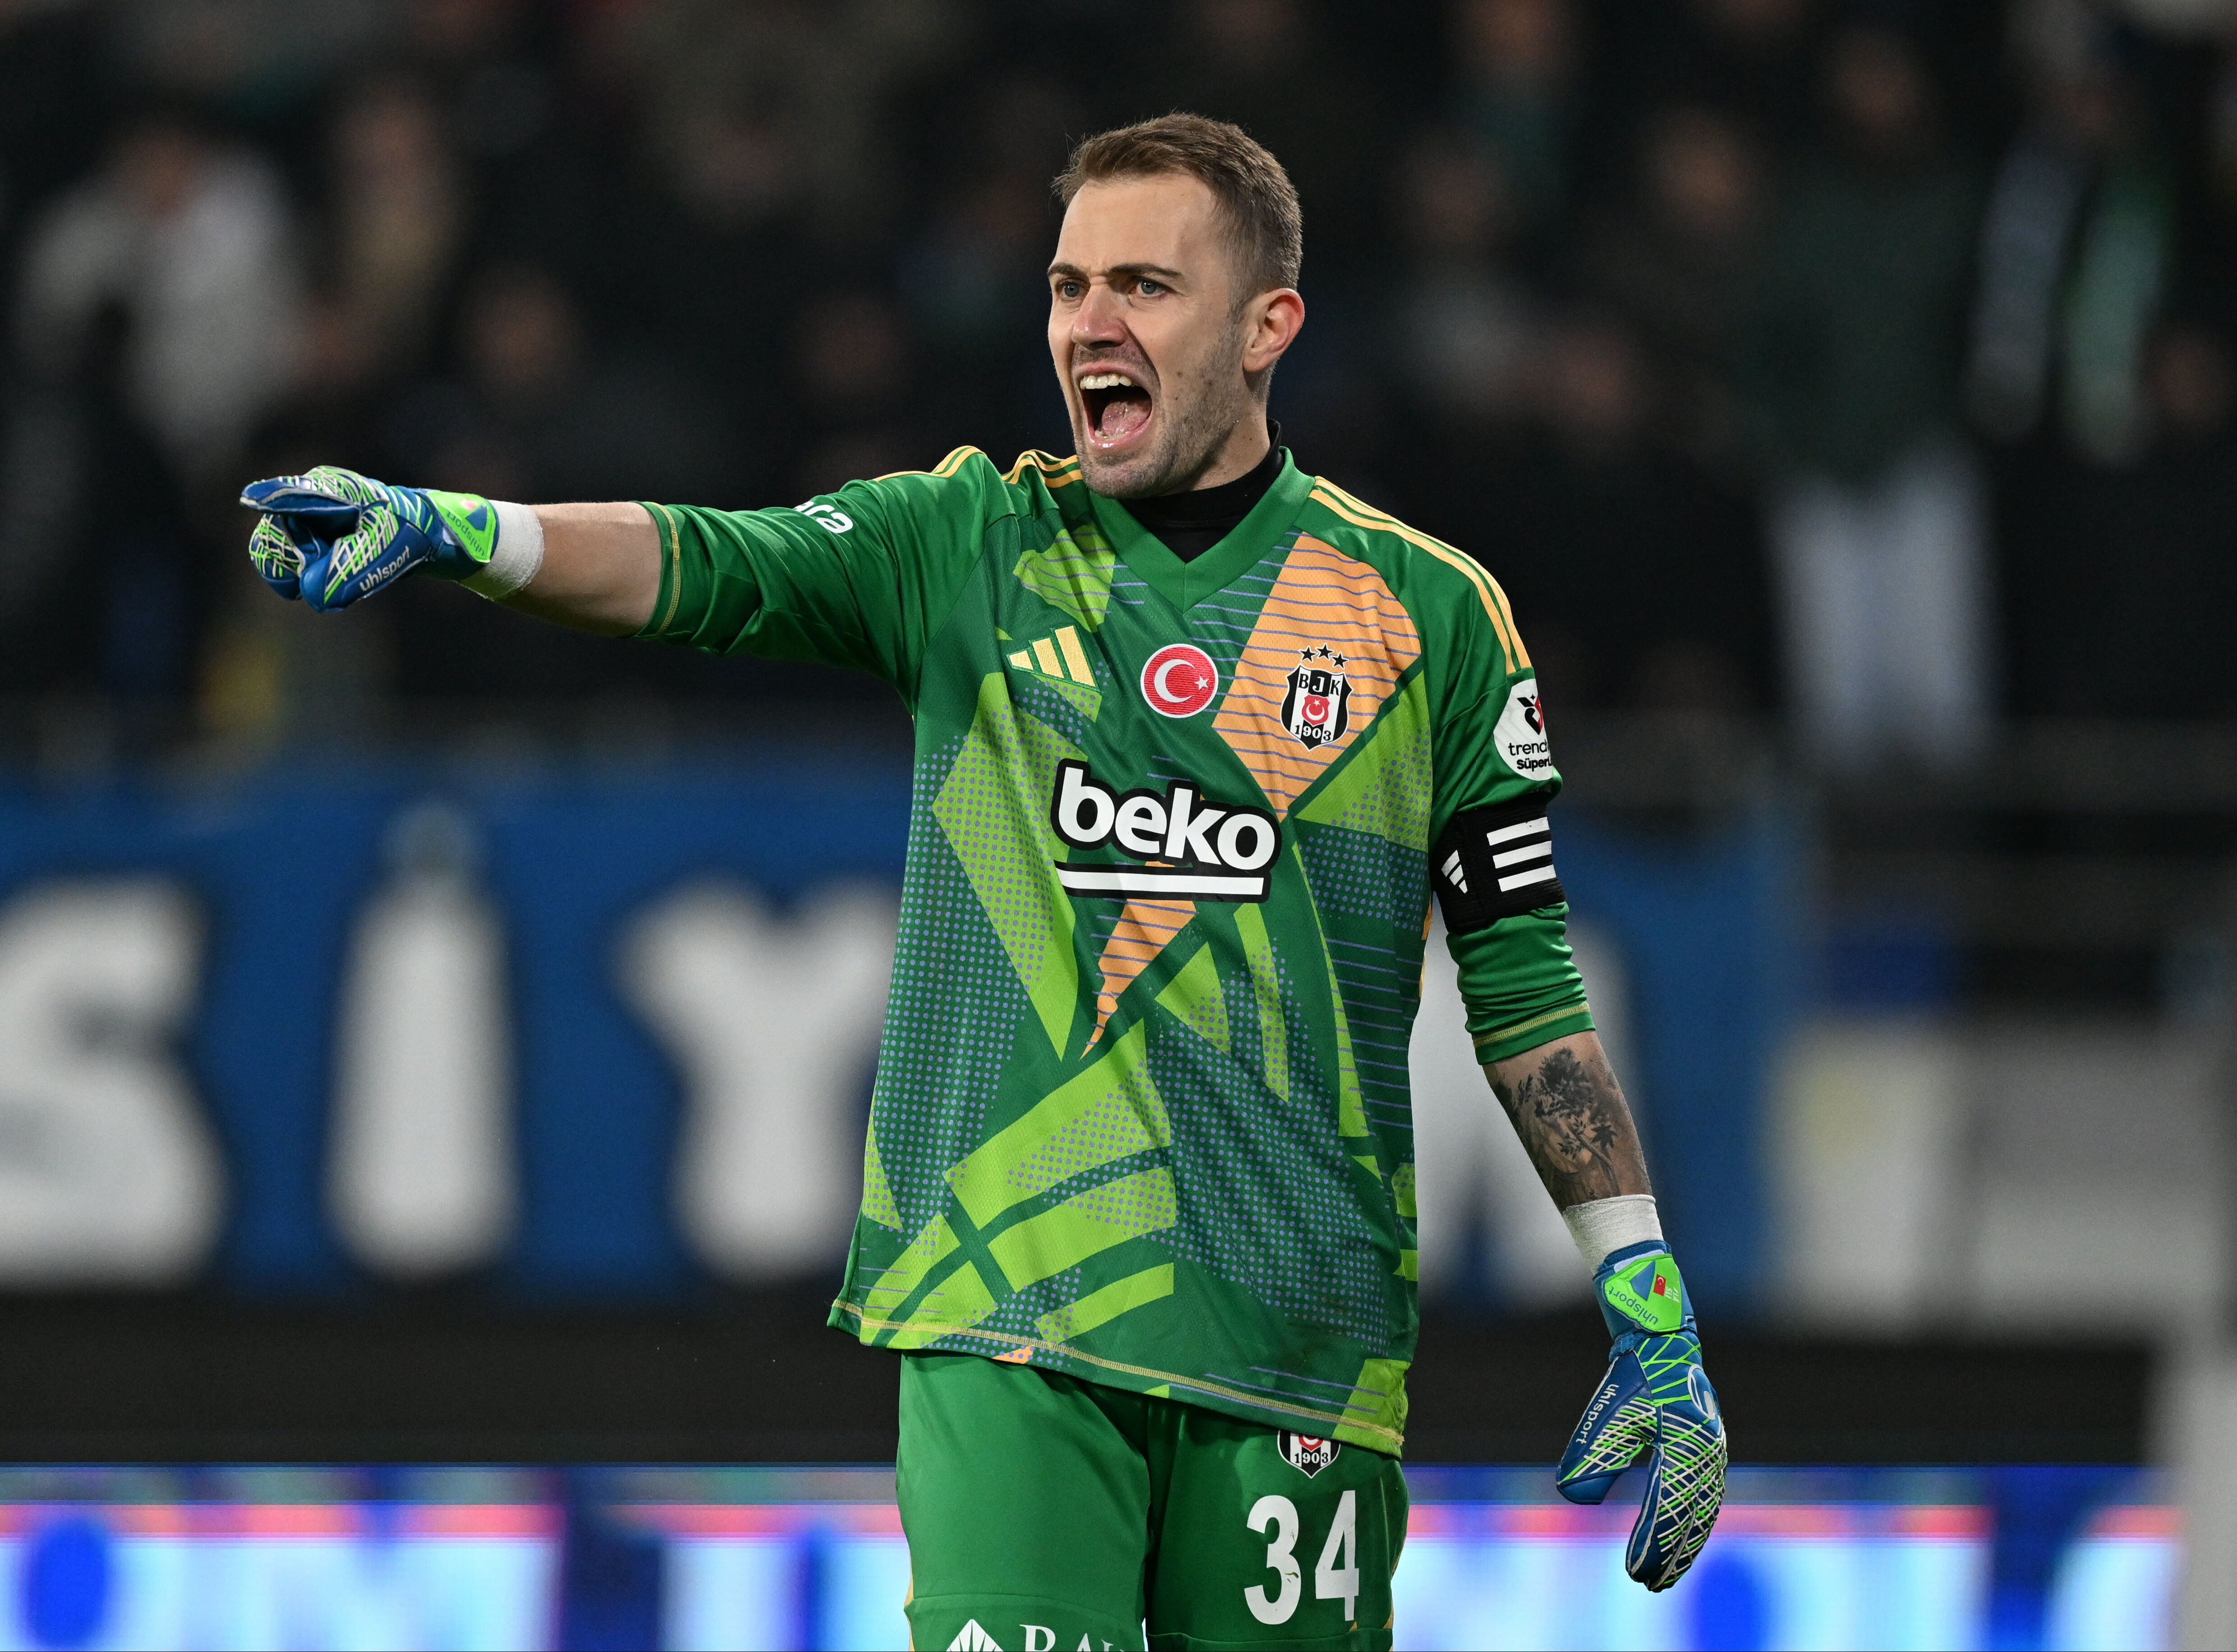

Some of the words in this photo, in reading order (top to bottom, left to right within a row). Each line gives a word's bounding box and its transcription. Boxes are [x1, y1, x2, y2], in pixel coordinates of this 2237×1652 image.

[447, 511, 485, 556] uhlsport
[360, 545, 410, 591] uhlsport
[1298, 673, 1341, 696] BJK
[1294, 724, 1331, 741] 1903
[1508, 739, 1549, 756] trend
[1058, 767, 1275, 870] beko
[1608, 1286, 1659, 1325] uhlsport
[1576, 1384, 1620, 1444] uhlsport
[1294, 1452, 1329, 1464] 1903
[1244, 1490, 1359, 1625] 34
